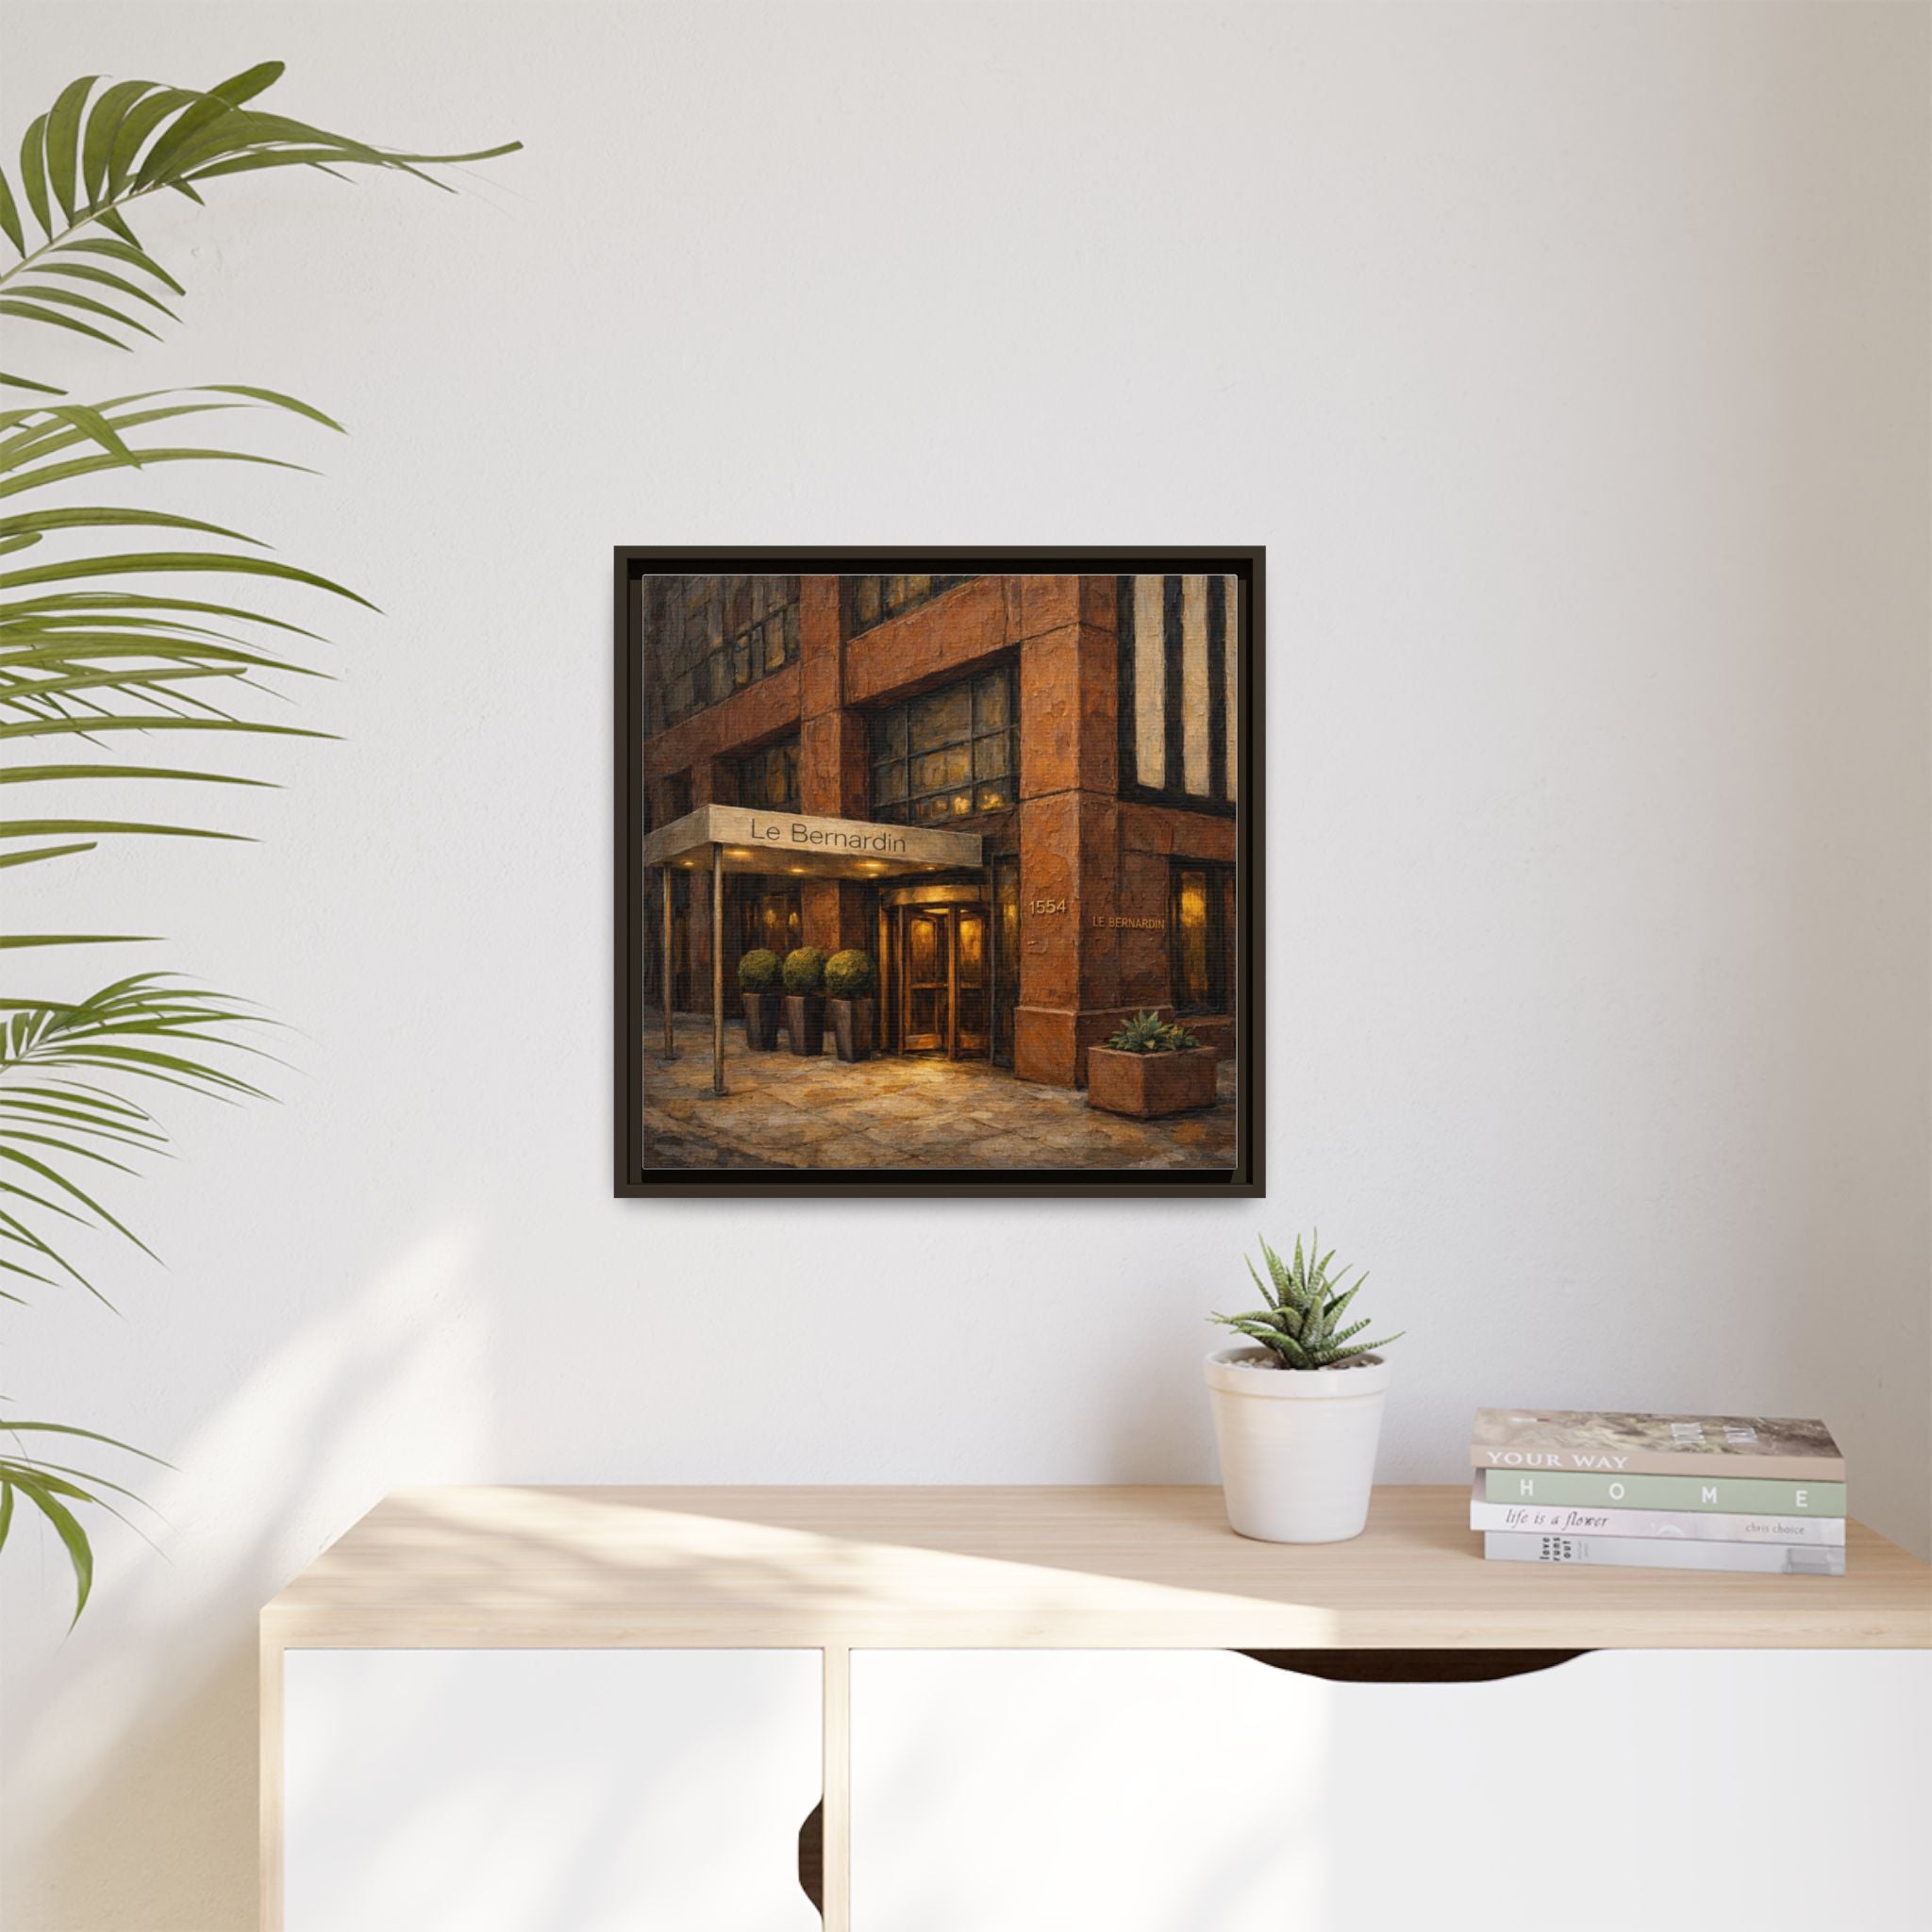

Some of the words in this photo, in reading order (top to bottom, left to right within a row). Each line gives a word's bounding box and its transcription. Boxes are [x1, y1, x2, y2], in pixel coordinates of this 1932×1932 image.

[751, 818, 780, 841] Le
[791, 823, 907, 853] Bernardin
[1029, 899, 1067, 915] 1554
[1092, 916, 1106, 928] LE
[1108, 917, 1165, 930] BERNARDIN
[1487, 1451, 1562, 1467] YOUR
[1573, 1454, 1630, 1470] WAY
[1506, 1509, 1529, 1528] life
[1534, 1511, 1545, 1525] is
[1551, 1514, 1559, 1525] a
[1562, 1511, 1608, 1531] flower
[1745, 1522, 1770, 1534] chris
[1773, 1523, 1806, 1535] choice
[1540, 1538, 1550, 1558] love
[1562, 1541, 1571, 1558] out
